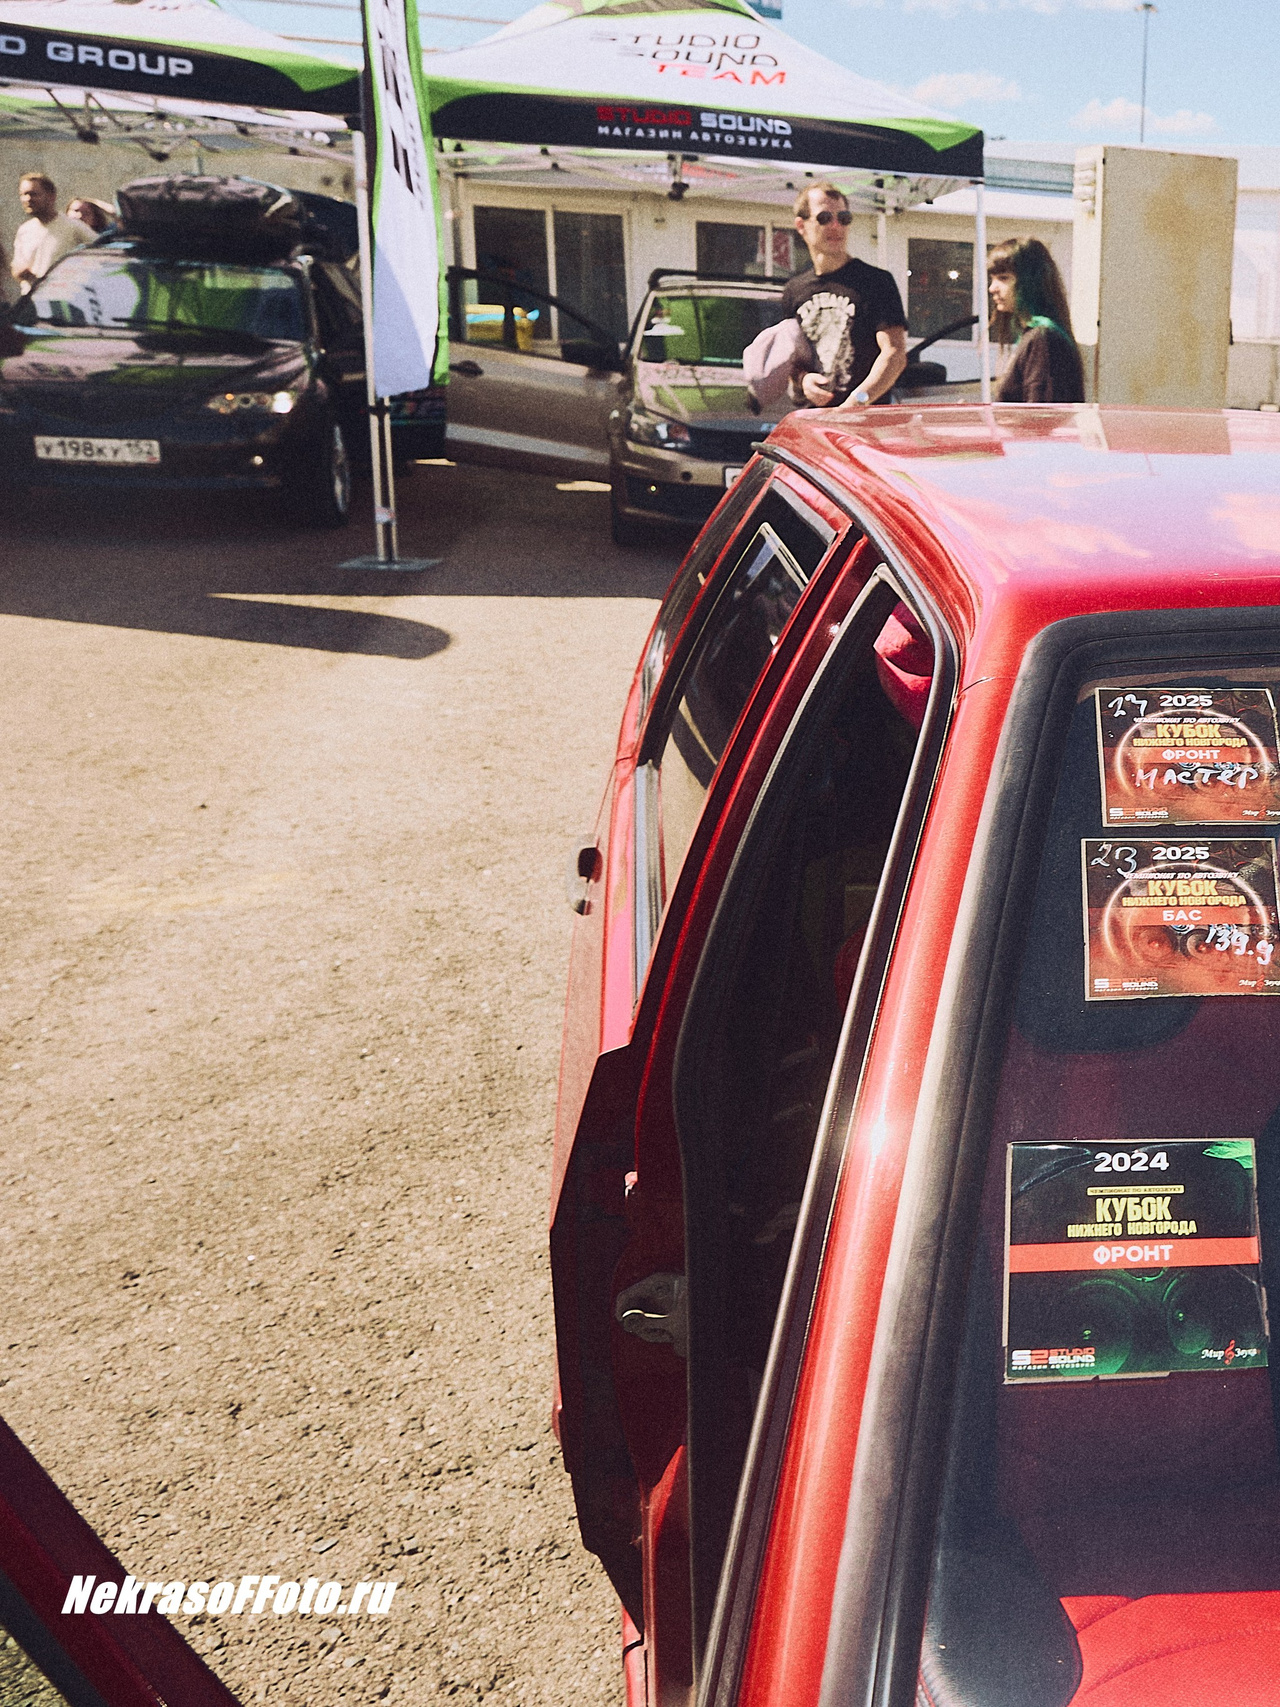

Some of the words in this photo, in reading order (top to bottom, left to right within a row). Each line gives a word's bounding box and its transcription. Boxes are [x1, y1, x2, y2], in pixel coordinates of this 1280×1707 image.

[46, 41, 194, 77] GROUP
[596, 105, 692, 126] STUDIO
[700, 112, 793, 135] SOUND
[597, 125, 683, 140] МАГАЗИН
[689, 131, 793, 149] АВТОЗВУКА
[1159, 694, 1213, 707] 2025
[1156, 724, 1221, 738] КУБОК
[1162, 749, 1221, 761] ФРОНТ
[1091, 842, 1137, 877] 23
[1152, 847, 1210, 860] 2025
[1148, 880, 1218, 896] КУБОК
[1122, 896, 1178, 906] НИЖНЕГО
[1179, 896, 1246, 907] НОВГОРОДА
[1163, 910, 1202, 921] БАС
[1093, 1151, 1170, 1173] 2024
[1095, 1196, 1172, 1222] КУБОК
[1067, 1223, 1123, 1238] НИЖНЕГО
[1127, 1220, 1197, 1235] НОВГОРОДА
[1093, 1244, 1173, 1265] ФРОНТ
[1048, 1354, 1096, 1364] SOUND
